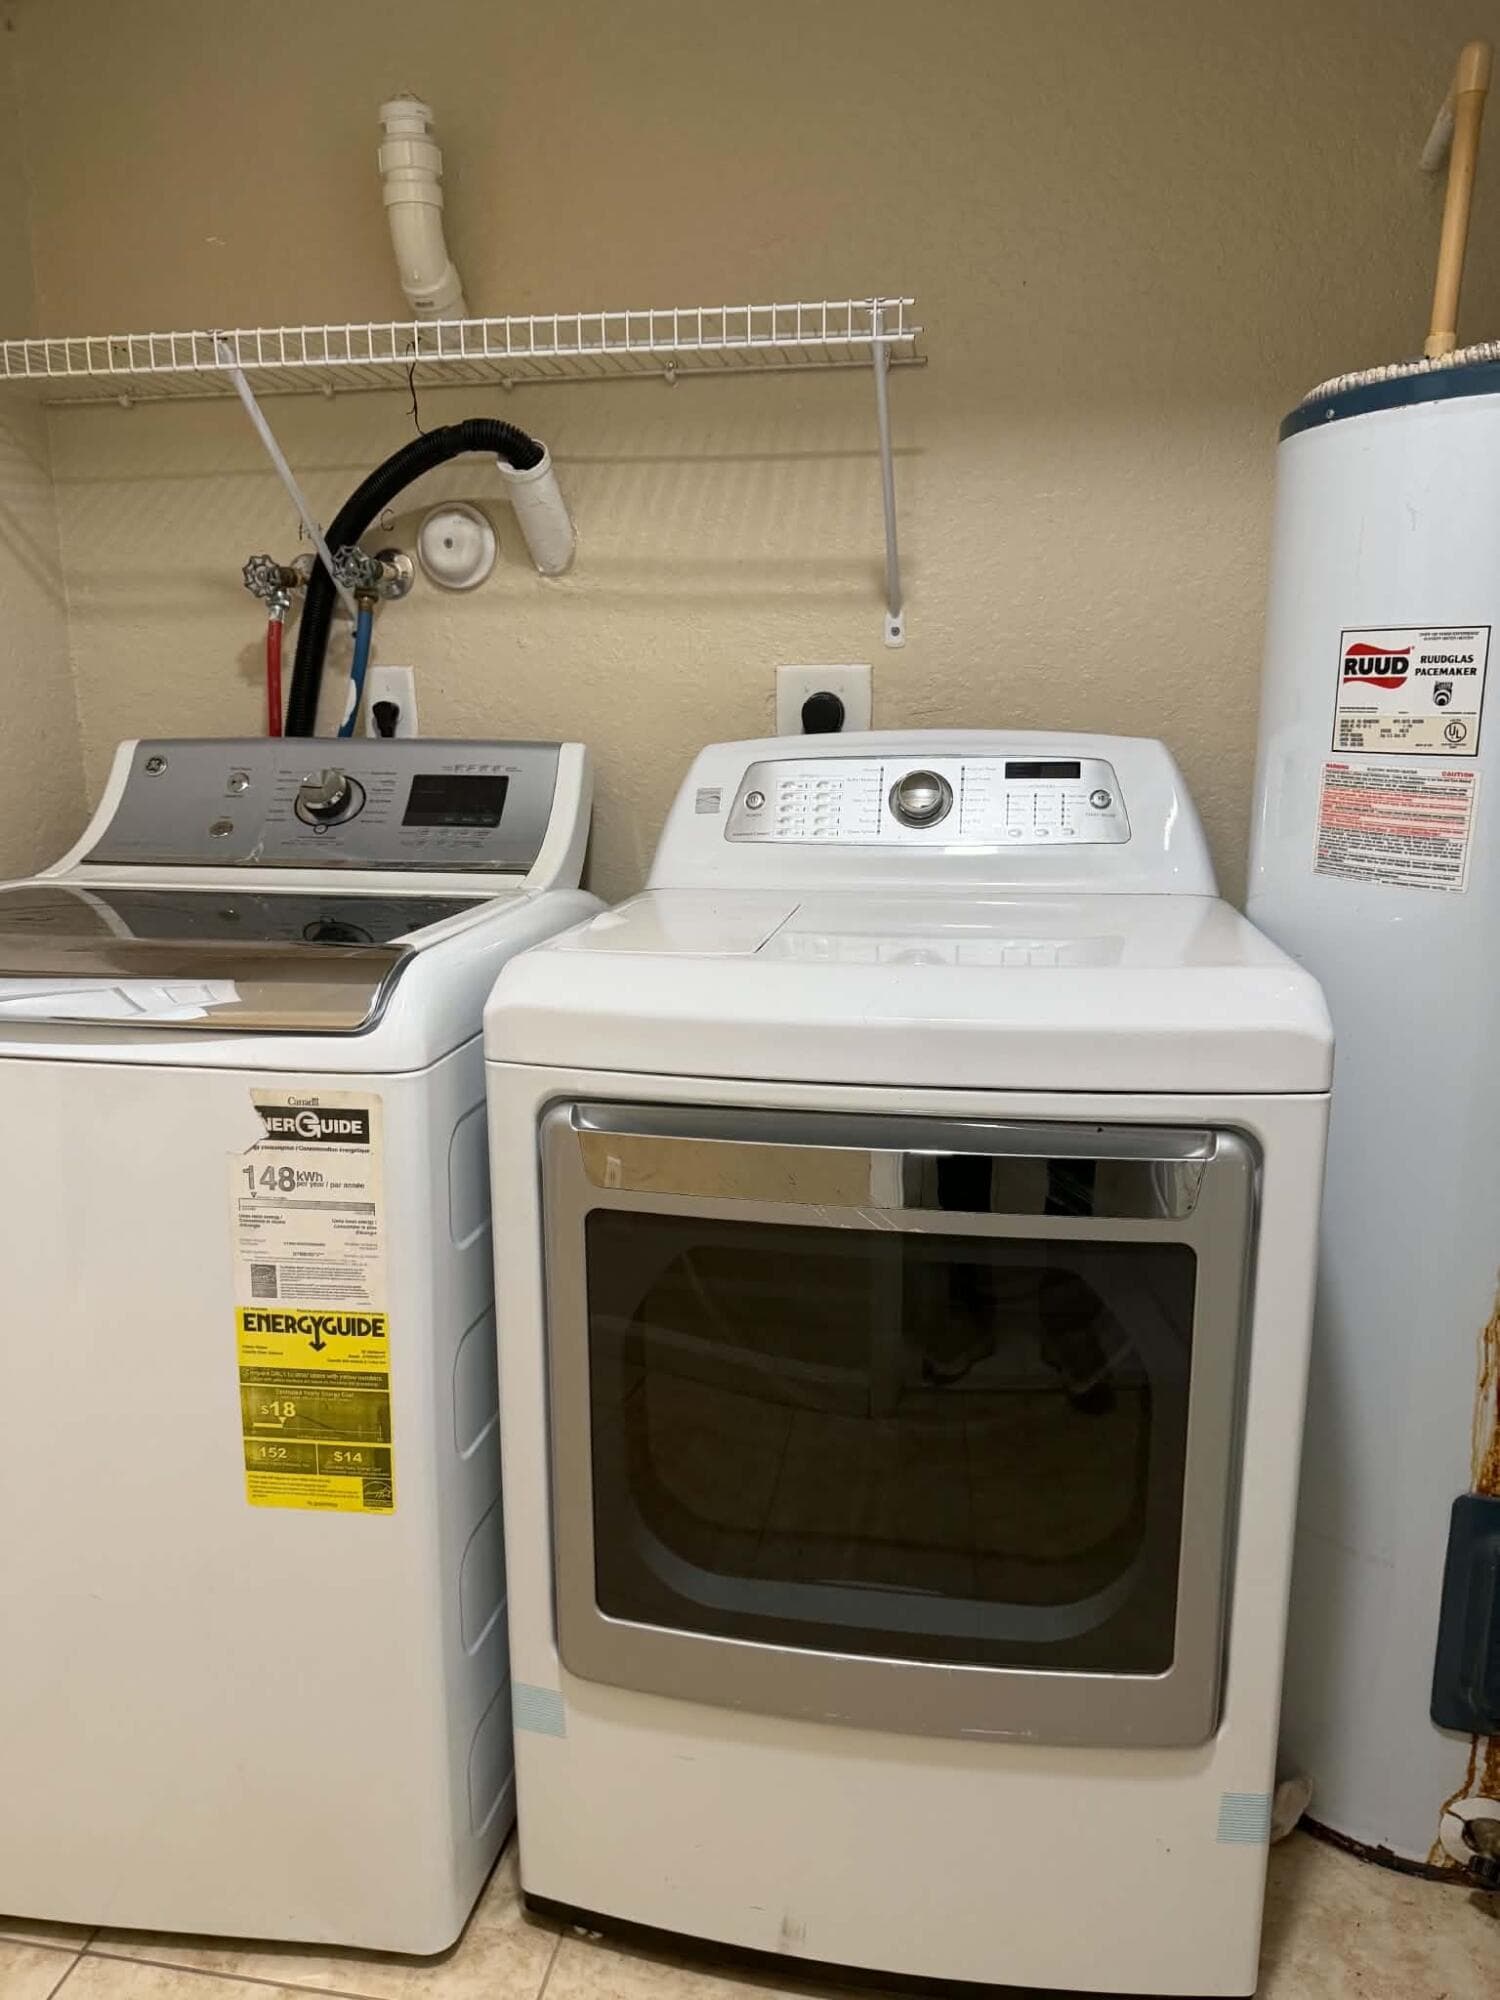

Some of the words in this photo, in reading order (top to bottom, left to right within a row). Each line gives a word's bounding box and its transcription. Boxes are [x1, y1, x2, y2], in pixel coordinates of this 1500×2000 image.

[1344, 657, 1409, 676] RUUD
[1420, 654, 1474, 664] RUUDGLAS
[1414, 667, 1477, 677] PACEMAKER
[264, 1111, 363, 1138] NERGUIDE
[242, 1165, 296, 1192] 148
[296, 1170, 323, 1182] kWh
[243, 1312, 385, 1340] ENERGYGUIDE
[261, 1401, 296, 1418] $18
[259, 1446, 287, 1459] 152
[333, 1451, 363, 1463] $14
